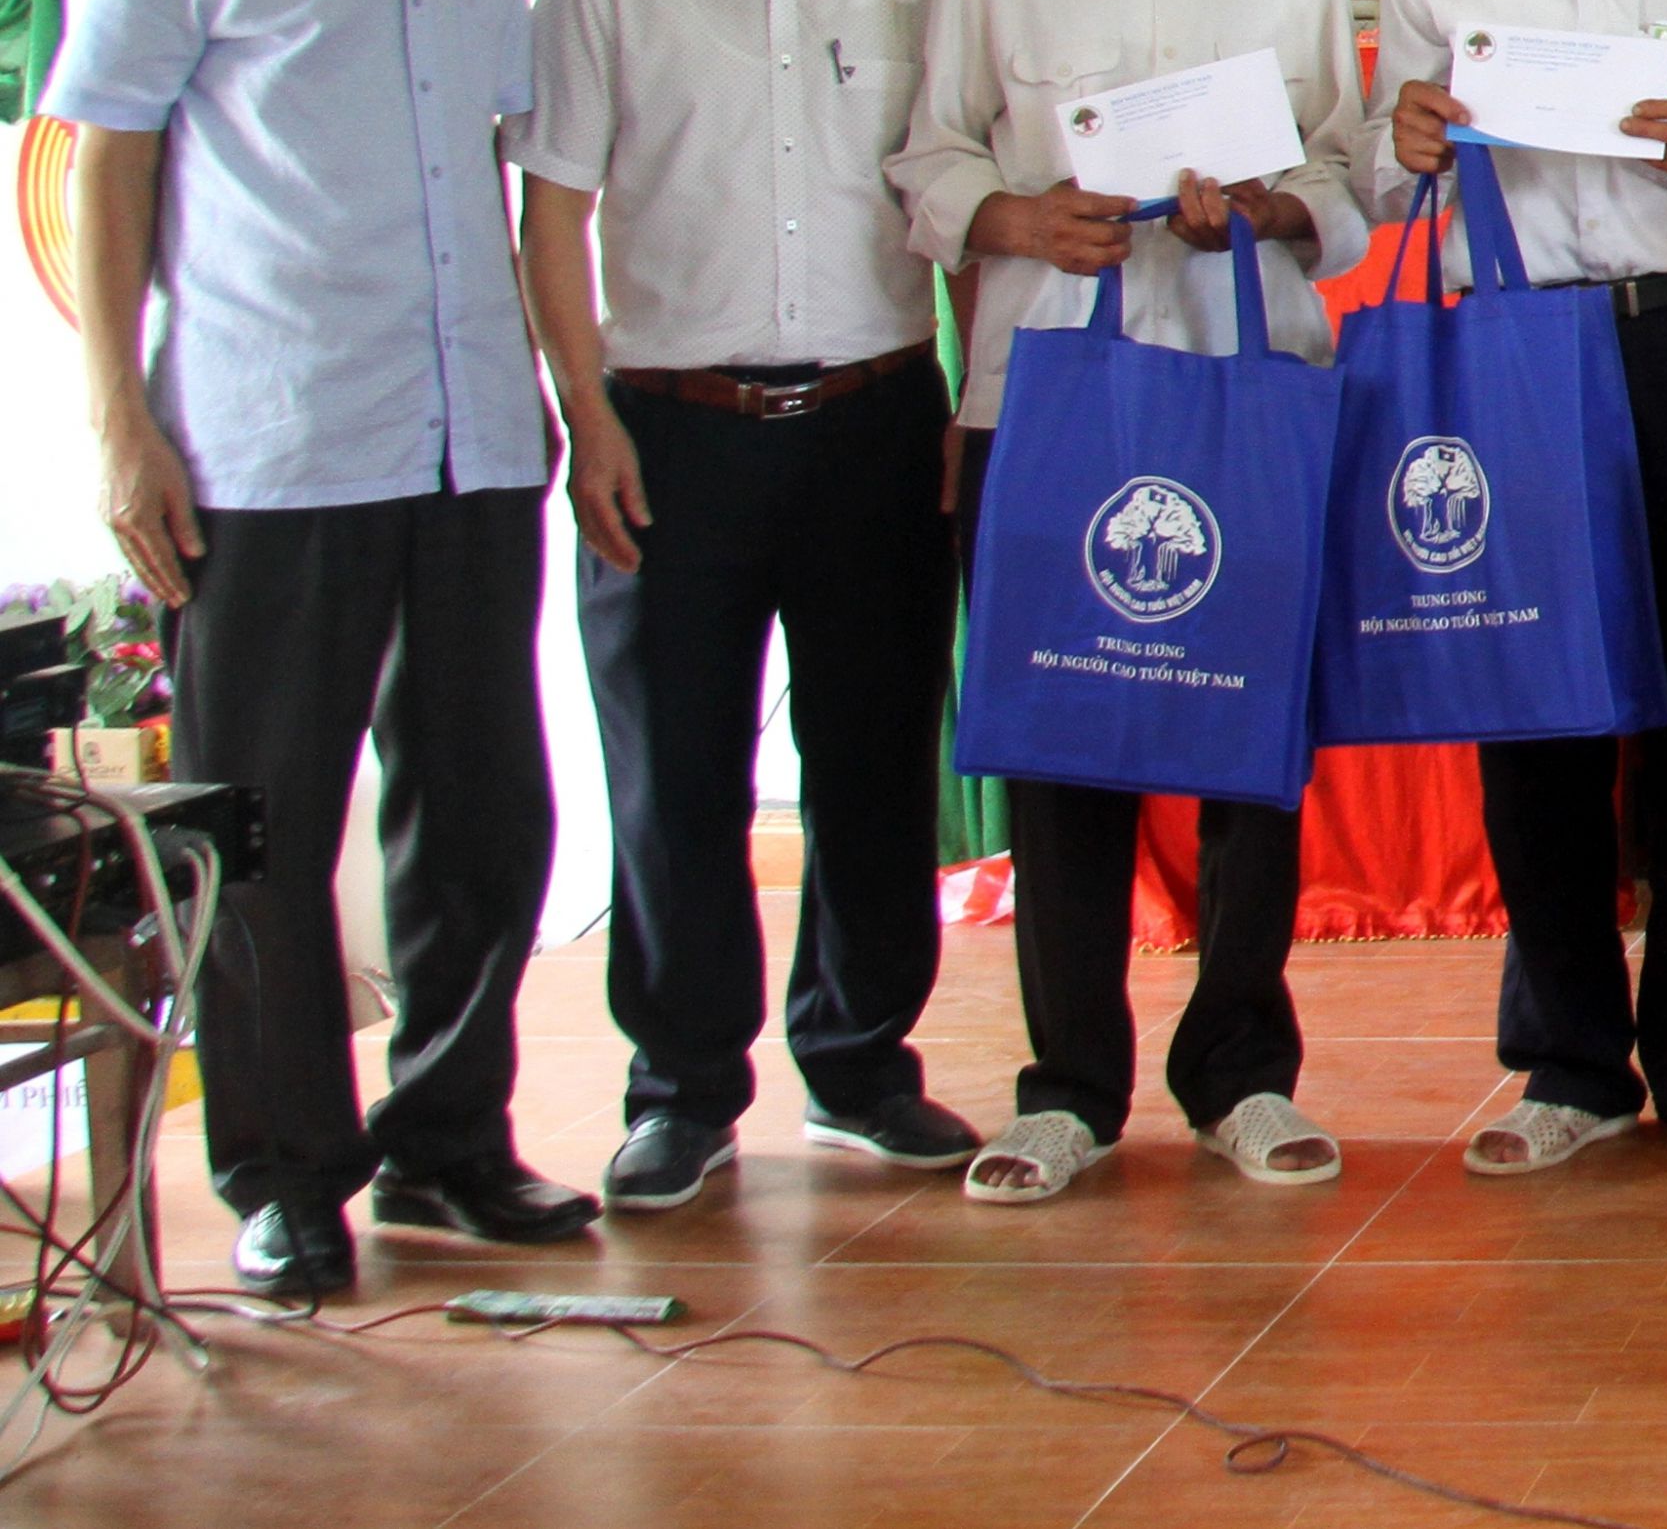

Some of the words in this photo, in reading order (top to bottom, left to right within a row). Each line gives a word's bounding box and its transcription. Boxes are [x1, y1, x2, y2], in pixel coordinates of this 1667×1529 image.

[1423, 613, 1449, 630] CAO
[1508, 607, 1539, 623] NAM
[1097, 636, 1142, 655] TRUNG
[1032, 649, 1058, 667] HỘI
[1061, 653, 1108, 673] NGƯỜI
[1139, 662, 1173, 682] TUỔI
[1176, 667, 1210, 687] VIỆT
[1212, 672, 1245, 688] NAM
